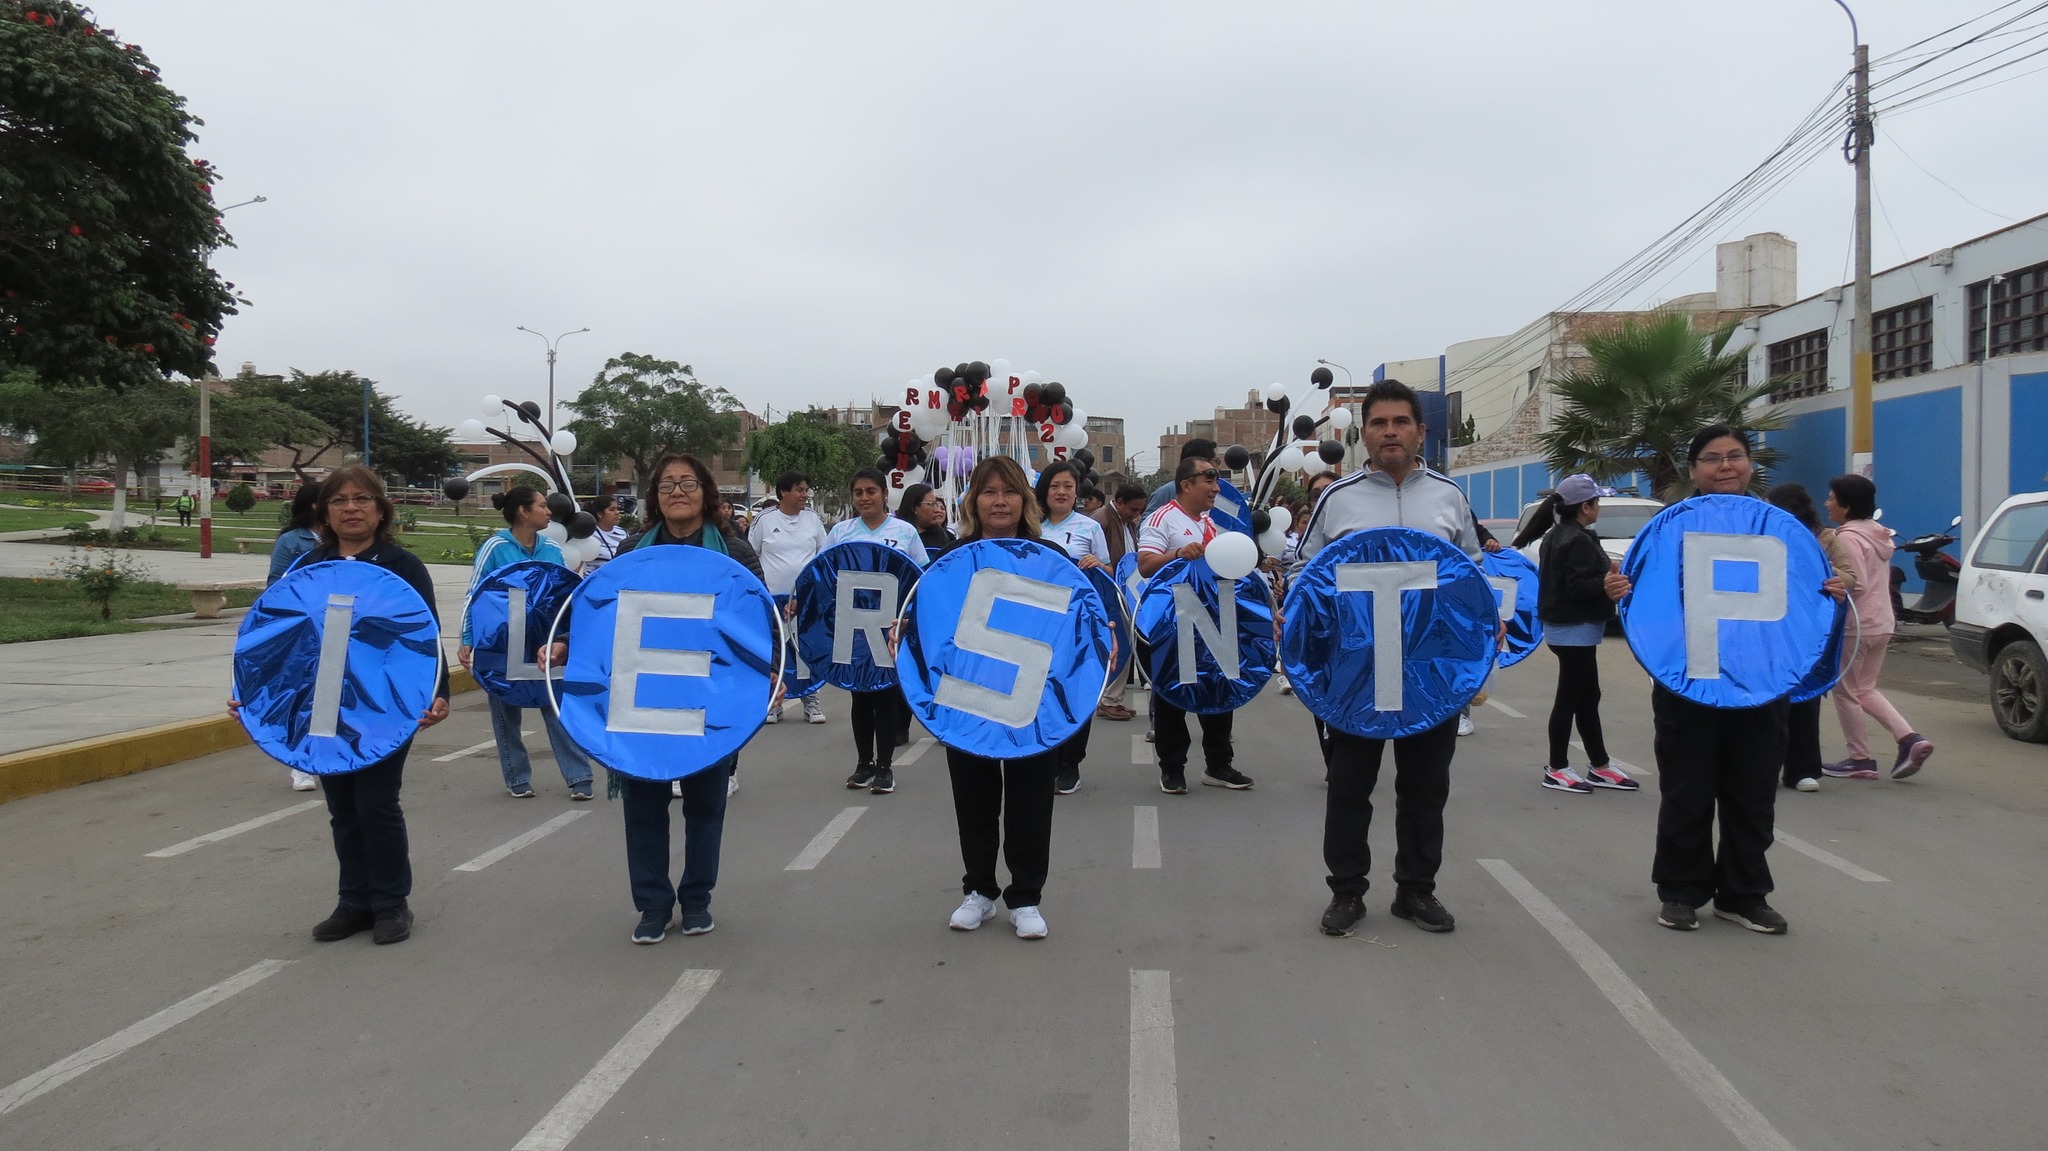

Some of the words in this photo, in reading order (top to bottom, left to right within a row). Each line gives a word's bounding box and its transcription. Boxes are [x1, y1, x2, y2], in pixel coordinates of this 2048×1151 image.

[891, 471, 905, 490] E
[898, 411, 912, 430] E
[905, 387, 920, 406] R
[928, 390, 941, 410] M
[1040, 423, 1055, 443] 2
[1053, 446, 1067, 463] 5
[308, 593, 356, 738] I
[605, 590, 716, 737] E
[933, 567, 1073, 729] S
[1335, 560, 1438, 711] T
[1683, 532, 1788, 680] P
[506, 587, 566, 681] L
[832, 569, 900, 668] R
[1171, 579, 1240, 684] N
